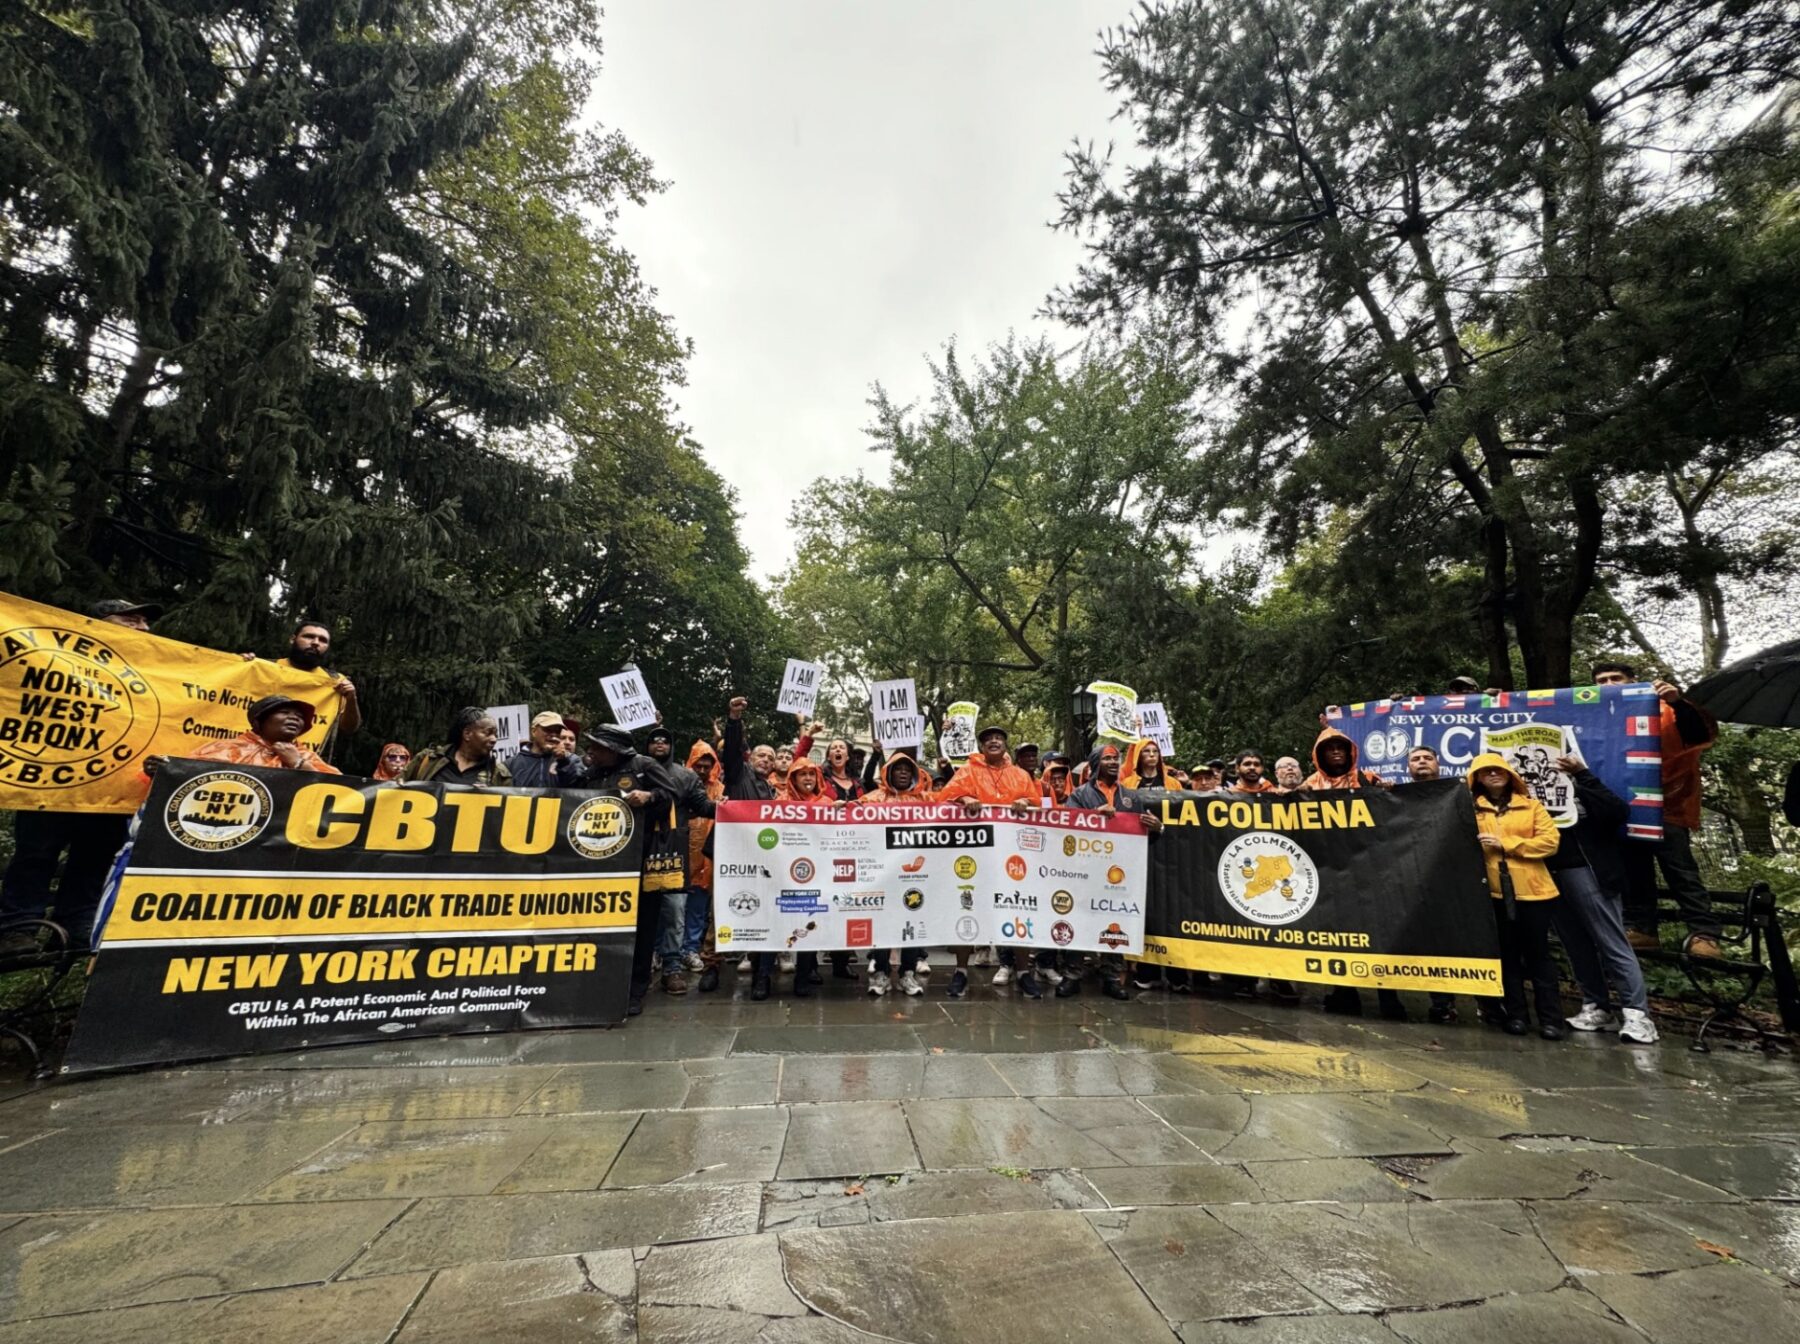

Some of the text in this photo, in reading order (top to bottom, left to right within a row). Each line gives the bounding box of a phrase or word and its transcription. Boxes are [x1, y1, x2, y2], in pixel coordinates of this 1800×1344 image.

[0, 631, 147, 695] AY YES TO
[77, 666, 100, 678] THE
[611, 678, 641, 699] I AM
[790, 667, 814, 687] I AM
[182, 682, 217, 703] The
[780, 688, 816, 711] WORTHY
[880, 688, 908, 711] I AM
[20, 692, 105, 724] WEST
[614, 700, 656, 726] WORTHY
[1143, 710, 1161, 728] AM
[1389, 711, 1537, 726] NEW YORK CITY
[0, 717, 105, 751] BRONX
[875, 717, 917, 741] WORTHY
[1491, 729, 1560, 743] MAKE THE ROAD
[169, 782, 198, 812] COALITION
[209, 773, 236, 781] BLACK
[235, 775, 259, 789] TRADE
[193, 789, 255, 805] CBTU
[205, 803, 236, 815] NY
[285, 783, 562, 854] CBTU
[584, 811, 620, 821] CBTU
[760, 804, 1107, 829] PASS THE CONSTRUCTION JUSTICE ACT
[1161, 798, 1376, 830] LA COLMENA
[592, 821, 610, 830] NY
[194, 841, 220, 851] HOME
[236, 825, 260, 844] LABOR
[892, 829, 987, 846] INTRO 910
[1078, 838, 1114, 854] DC9
[1228, 836, 1302, 861] LA COLMENA
[720, 864, 757, 875] DRUM
[1050, 868, 1089, 880] Osborne
[1223, 863, 1313, 920] Staten Island Community Job Center
[130, 890, 633, 922] COALITION OF BLACK TRADE UNIONISTS
[1090, 898, 1140, 915] LCLAA
[1001, 917, 1034, 939] obt
[1180, 920, 1370, 948] COMMUNITY JOB CENTER
[161, 943, 598, 994] NEW YORK CHAPTER
[1371, 965, 1497, 982] @LACOLMENANYC
[228, 984, 547, 1016] CBTU Is A Potent Economic And Political Force
[245, 998, 532, 1031] Within The African American Community
